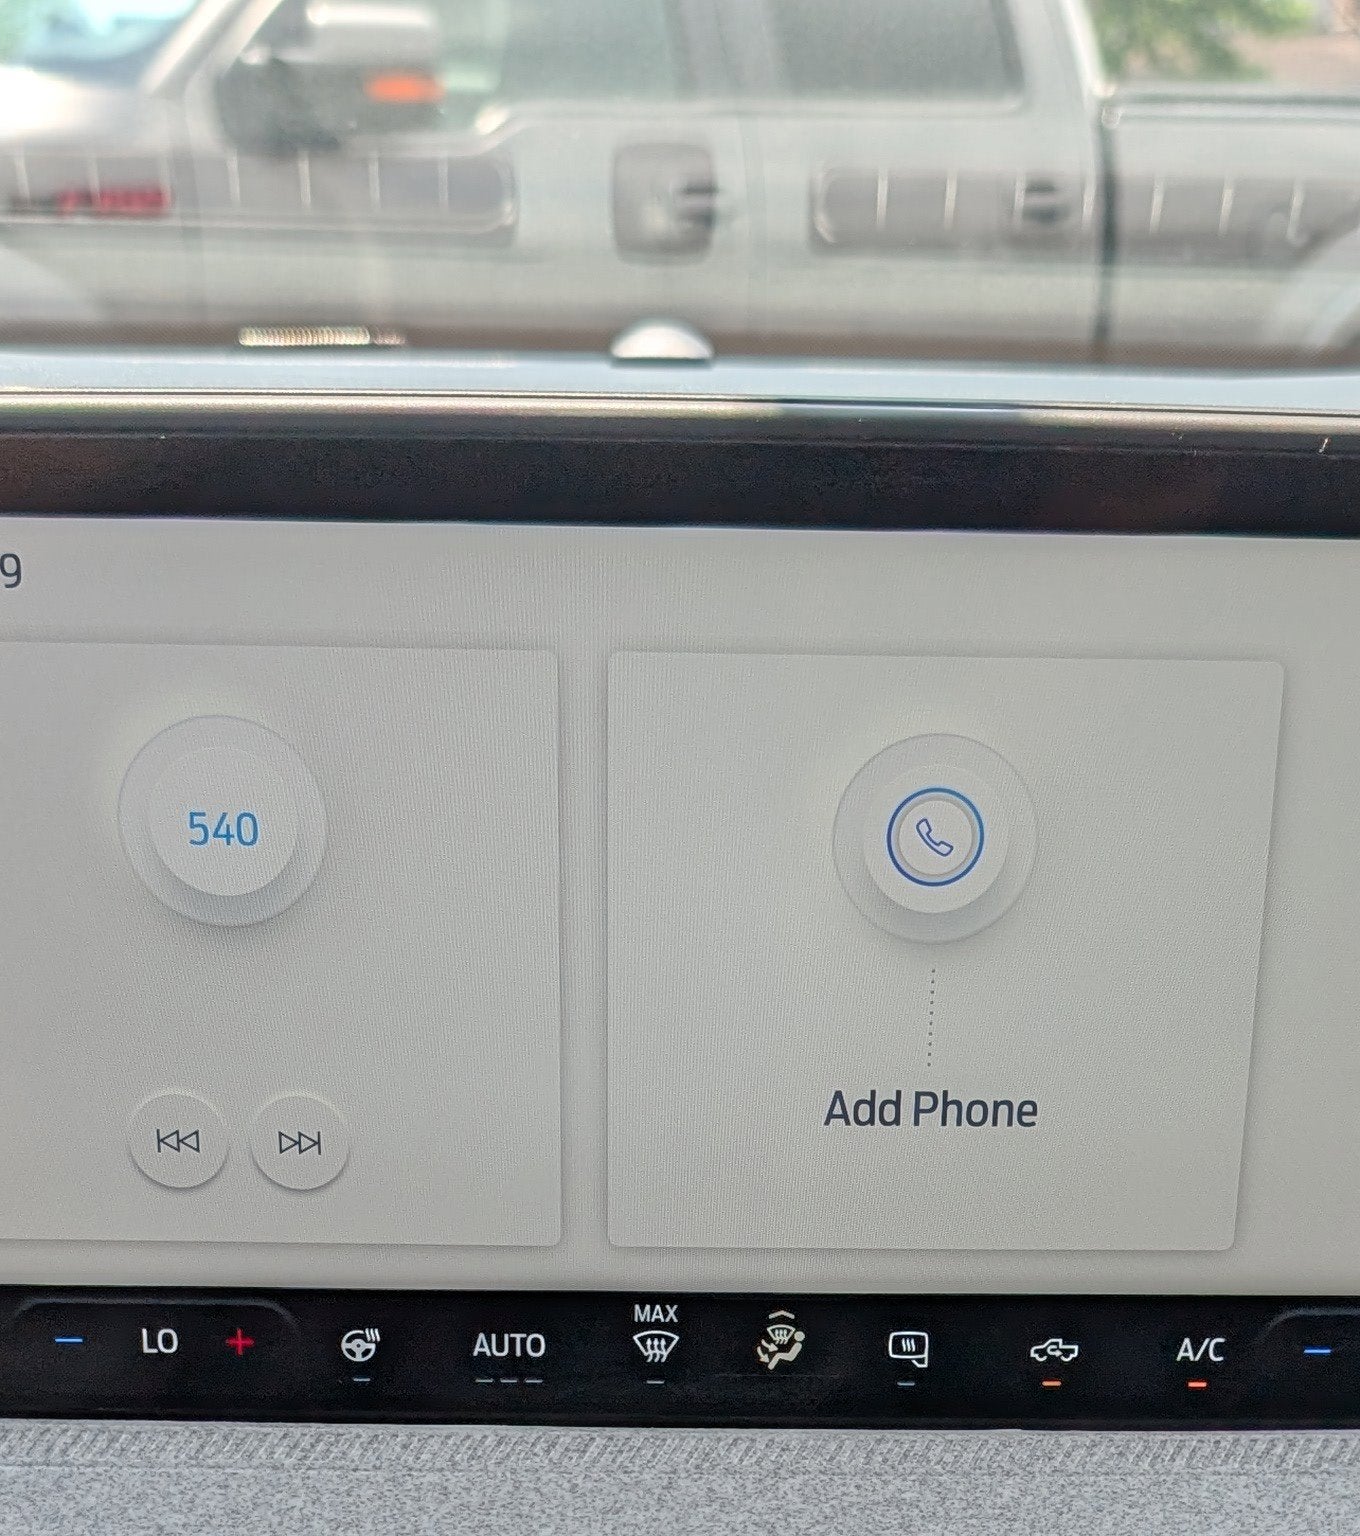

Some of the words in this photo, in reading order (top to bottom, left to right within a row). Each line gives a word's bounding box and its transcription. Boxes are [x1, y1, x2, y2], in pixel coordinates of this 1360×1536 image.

[189, 811, 259, 847] 540
[823, 1089, 902, 1127] Add
[913, 1089, 1038, 1128] Phone
[634, 1304, 678, 1323] MAX
[141, 1327, 179, 1354] LO
[472, 1332, 546, 1358] AUTO
[1176, 1337, 1226, 1362] A/C
